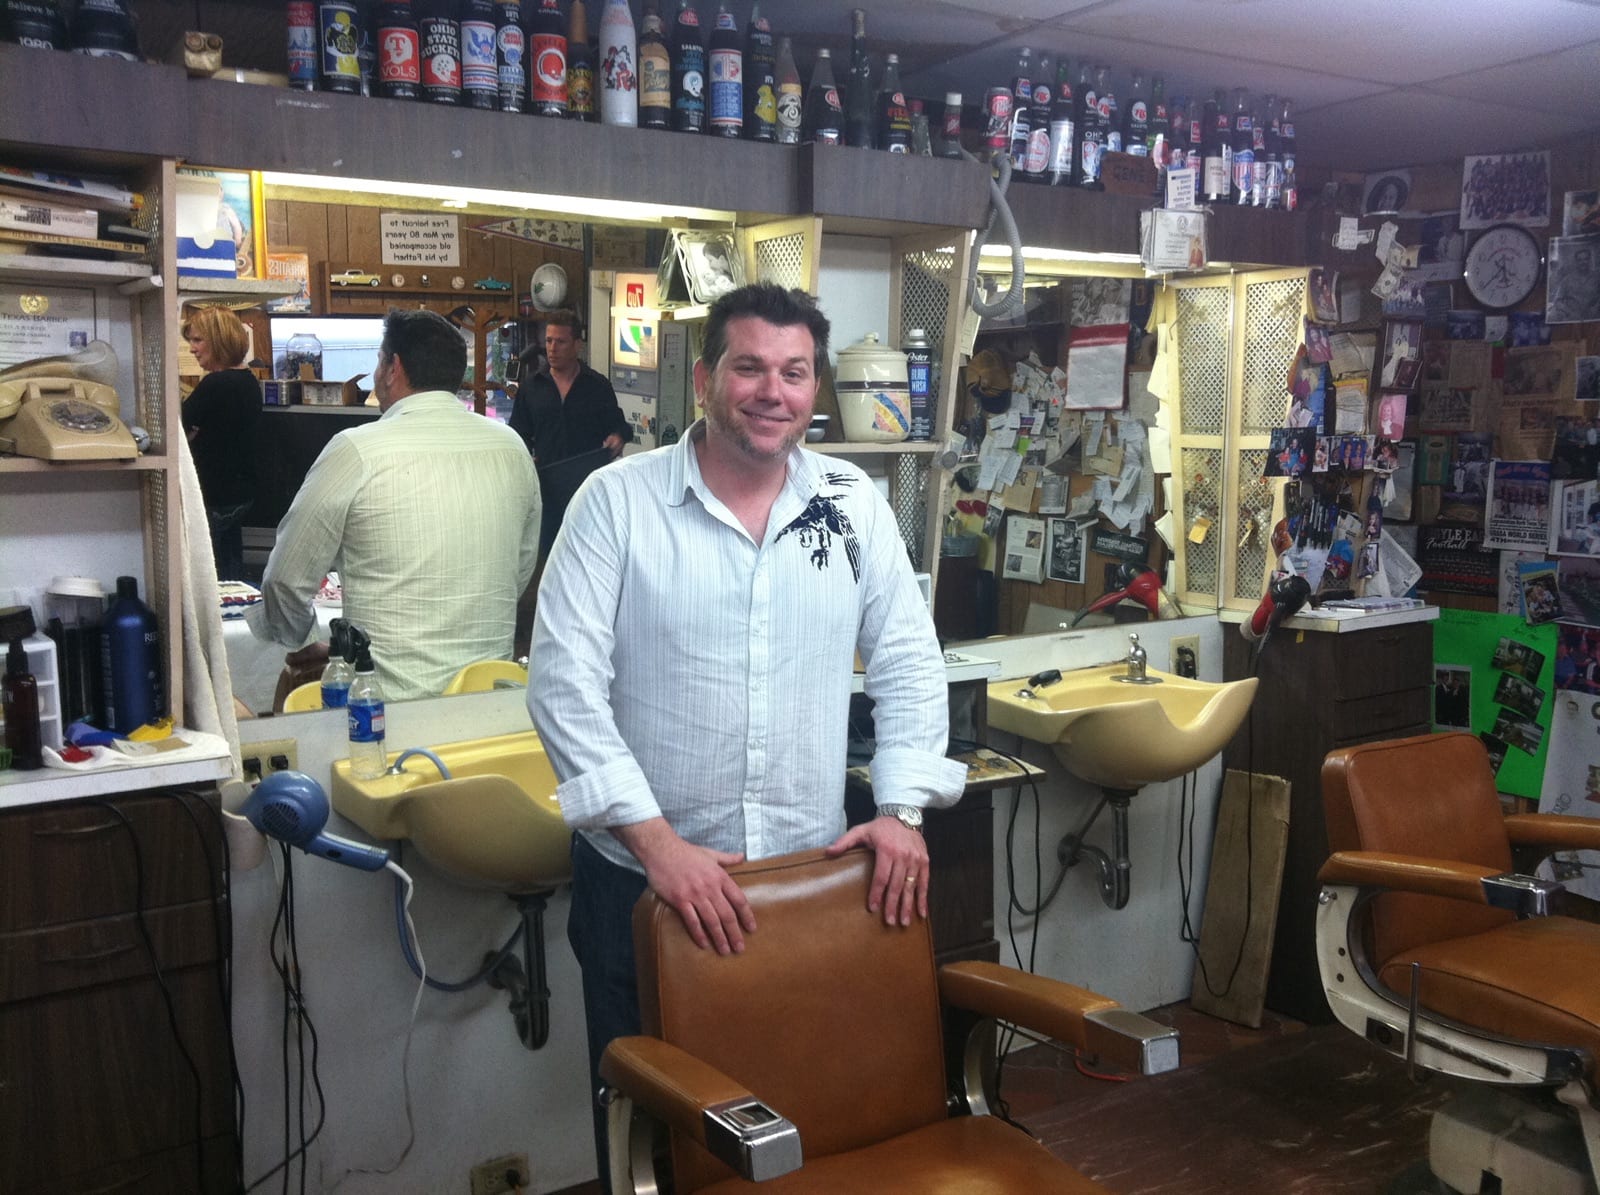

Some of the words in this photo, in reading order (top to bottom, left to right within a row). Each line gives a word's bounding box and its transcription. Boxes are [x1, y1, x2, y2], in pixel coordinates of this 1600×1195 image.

[430, 24, 457, 36] OHIO
[427, 34, 458, 47] STATE
[382, 64, 417, 79] VOLS
[33, 315, 68, 323] BARBER
[907, 352, 929, 362] Oster
[911, 381, 927, 393] WASH
